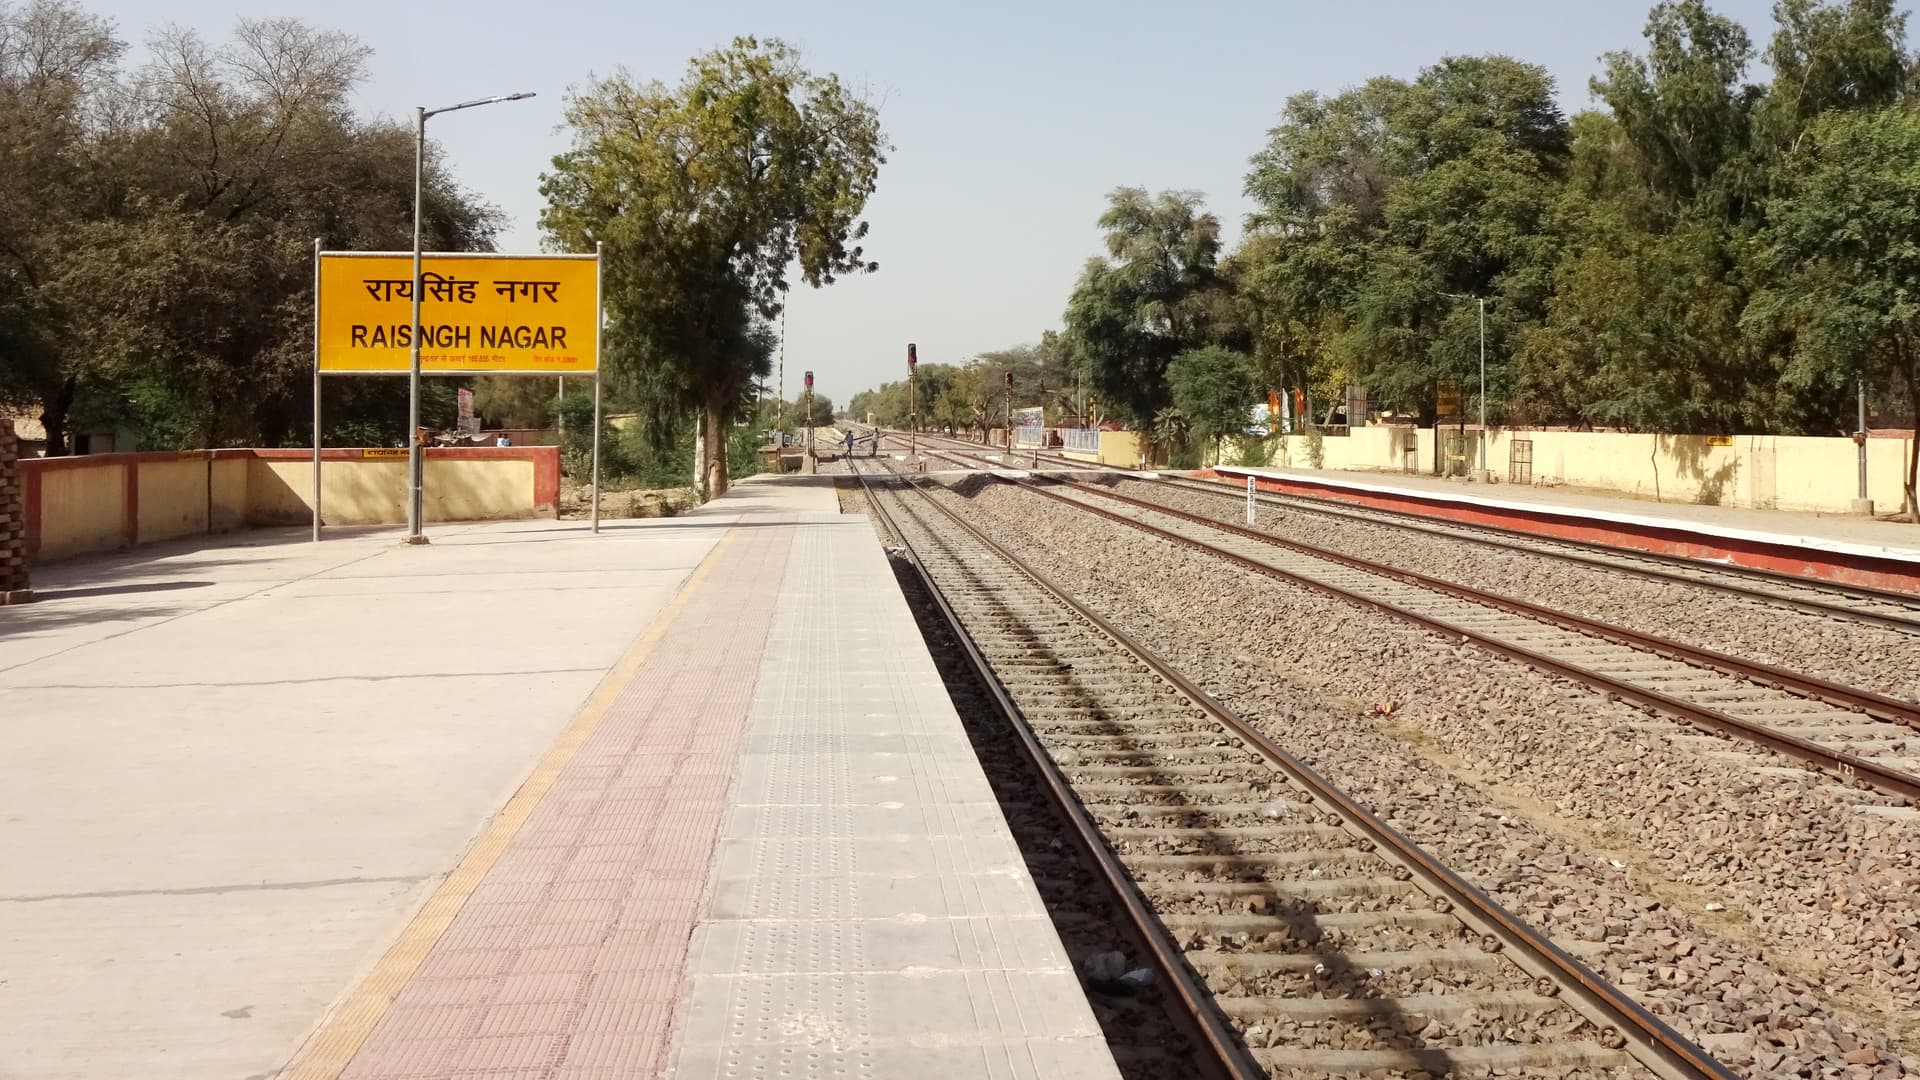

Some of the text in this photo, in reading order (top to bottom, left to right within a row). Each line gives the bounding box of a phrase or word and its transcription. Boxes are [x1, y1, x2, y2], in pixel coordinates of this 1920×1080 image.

[363, 272, 560, 303] रायसिंह नगर
[352, 325, 567, 349] RAISNGH NAGAR
